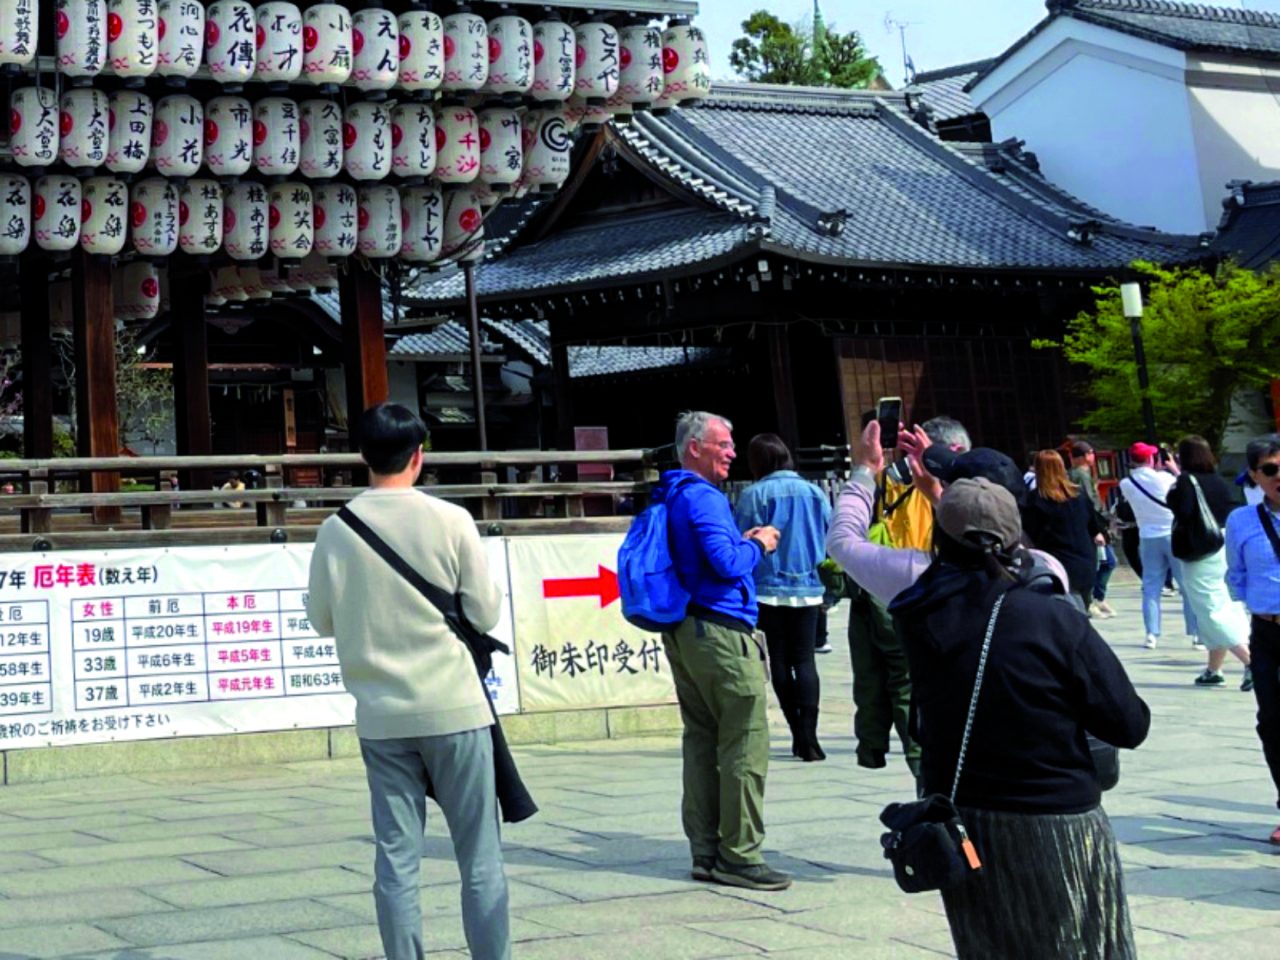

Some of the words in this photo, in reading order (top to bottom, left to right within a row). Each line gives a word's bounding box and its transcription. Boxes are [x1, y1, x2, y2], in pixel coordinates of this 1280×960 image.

[329, 14, 351, 70] 小扇
[377, 15, 397, 71] えん
[122, 98, 147, 160] 上田梅
[180, 105, 201, 165] 小花
[229, 103, 251, 162] 市光
[280, 102, 296, 165] 豆千佳
[321, 103, 339, 169] 久富美
[371, 107, 386, 170] ちもと
[417, 107, 432, 169] ちもと
[291, 188, 311, 250] 柳笑会
[421, 192, 440, 252] カトレヤ
[33, 563, 97, 589] 厄年表
[98, 566, 158, 586] (数え年)
[83, 602, 114, 617] 女性
[148, 598, 180, 614] 前厄
[226, 594, 257, 610] 本厄
[132, 624, 199, 638] 平成20年生
[212, 620, 274, 635] 平成19年生
[287, 617, 312, 632] 平成
[84, 627, 115, 643] 19歳
[138, 653, 195, 668] 平成6年生
[218, 647, 271, 664] 平成5年生
[292, 645, 335, 659] 平成4年
[531, 638, 662, 679] 御朱印受付
[83, 656, 117, 672] 33歳
[217, 675, 275, 693] 平成元年生
[290, 672, 343, 689] 昭和63年
[85, 685, 119, 702] 37歳
[139, 682, 198, 698] 平成2年生
